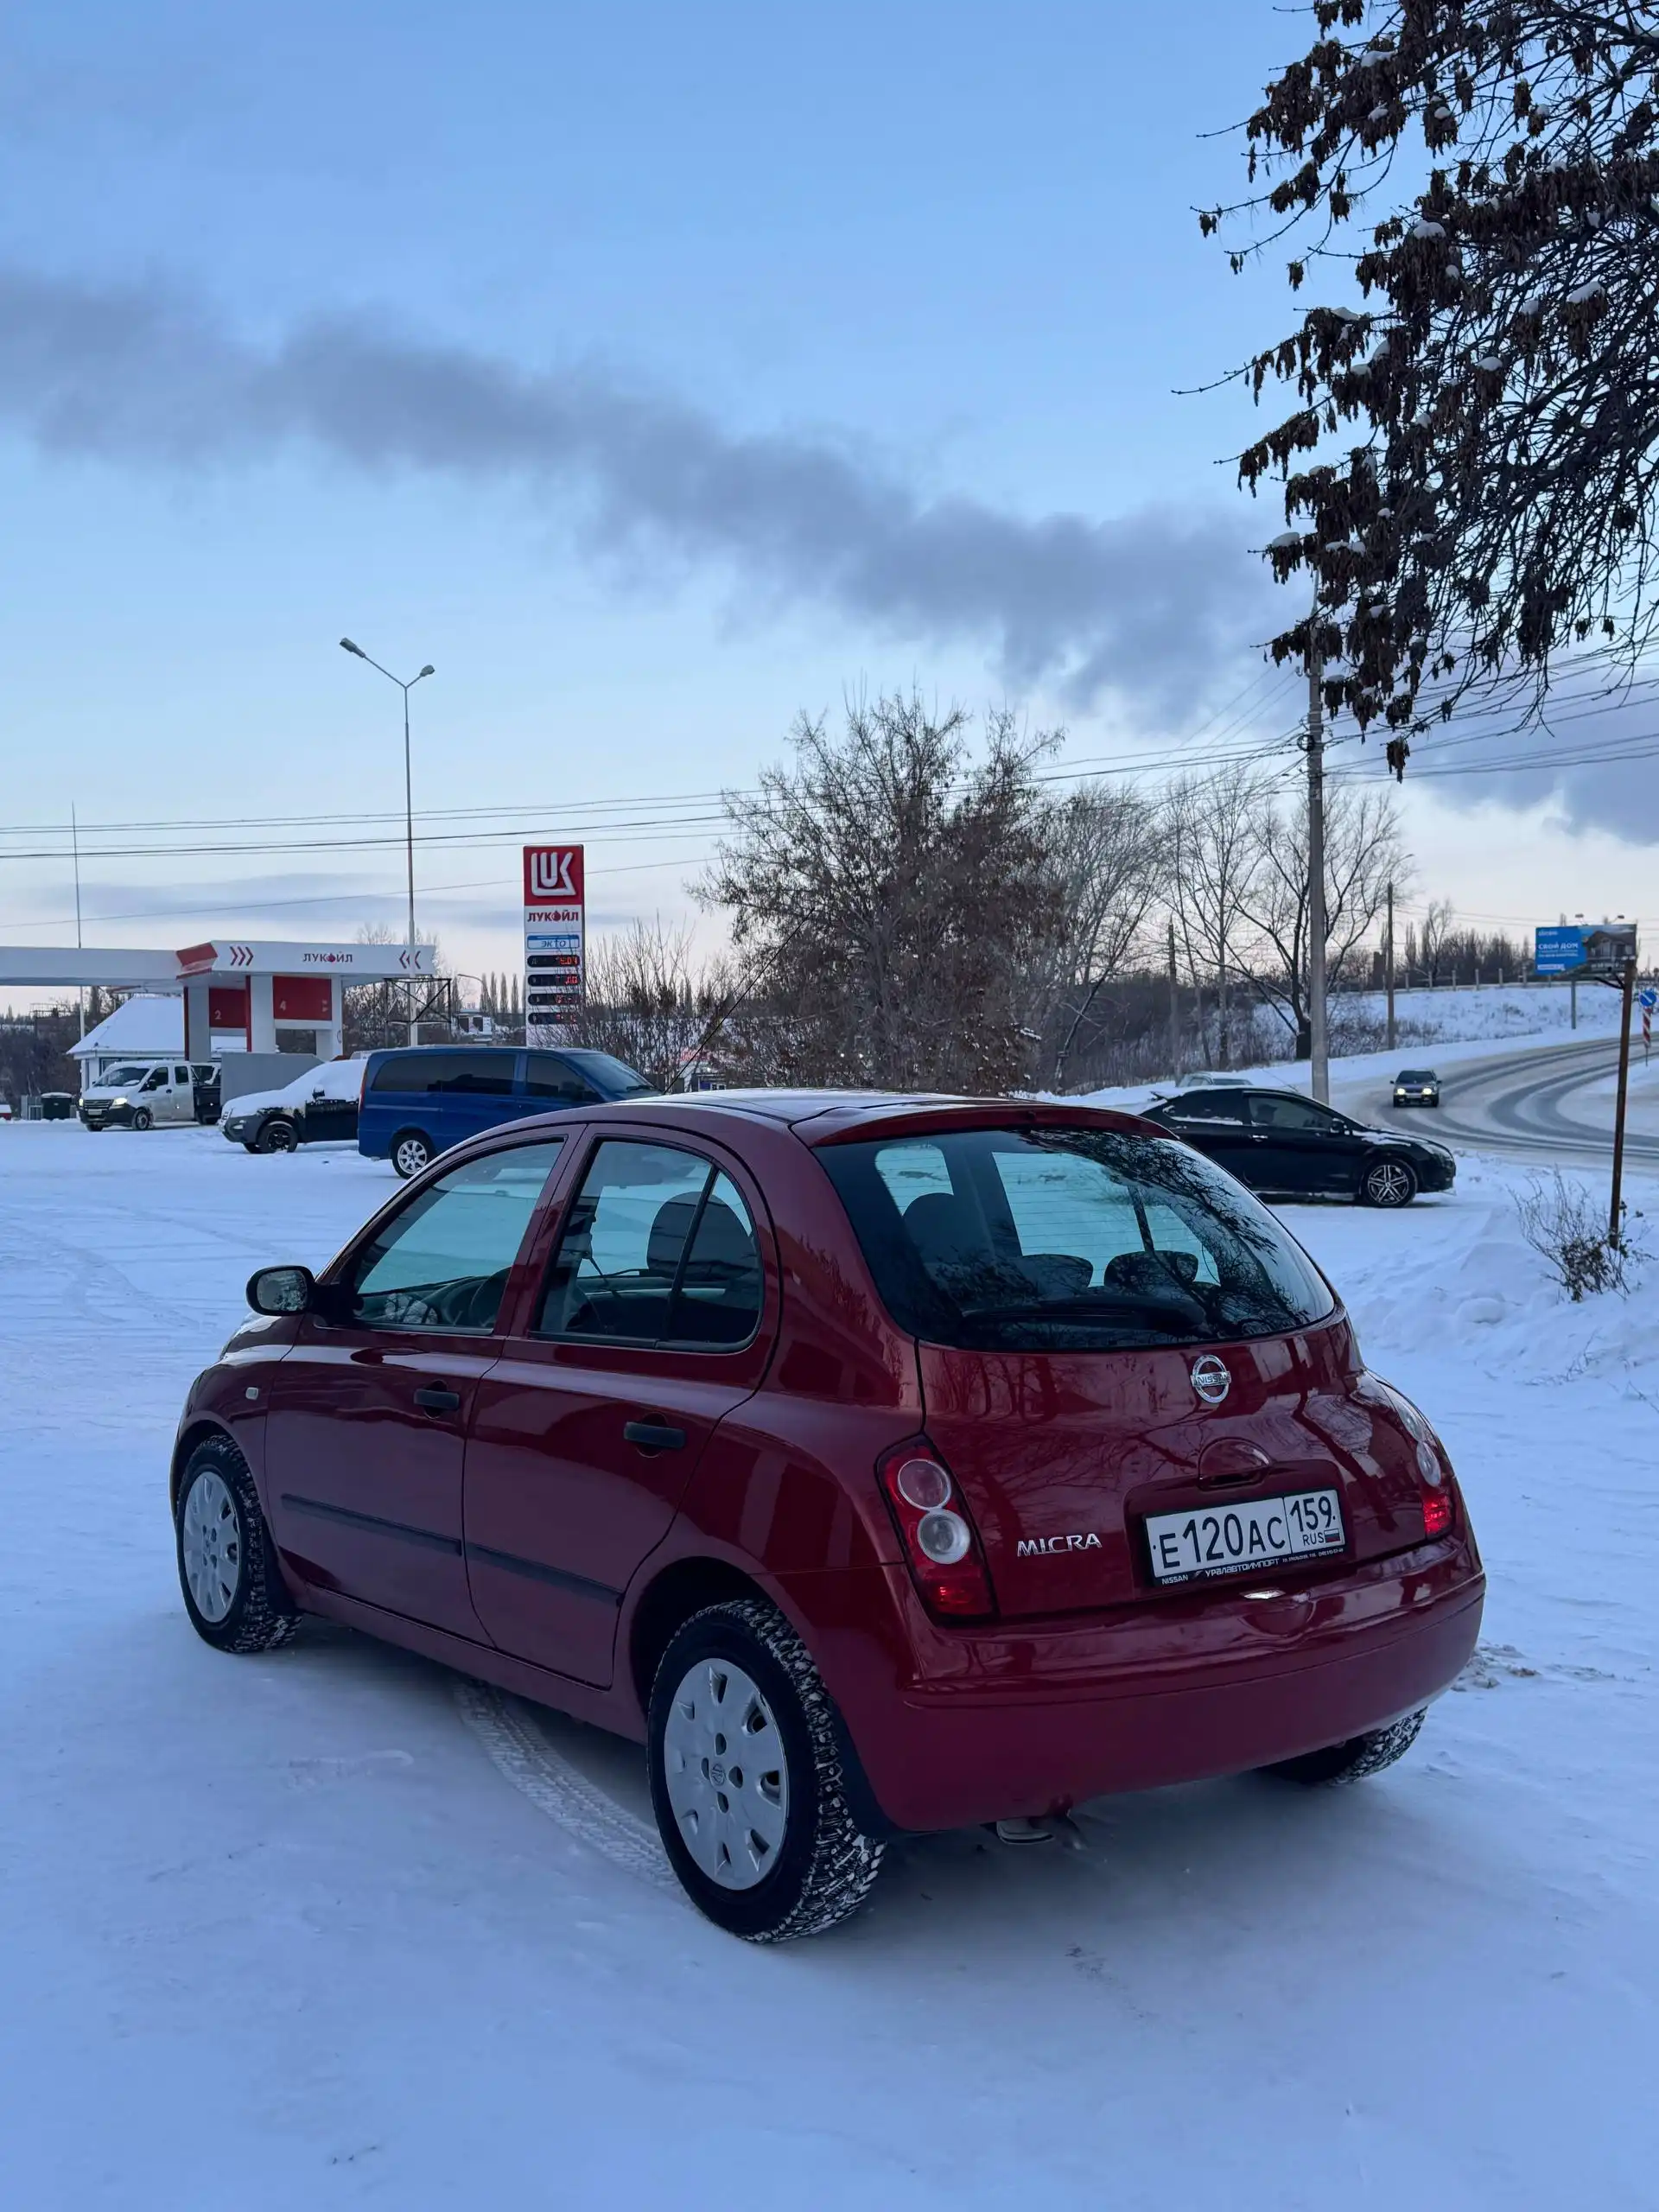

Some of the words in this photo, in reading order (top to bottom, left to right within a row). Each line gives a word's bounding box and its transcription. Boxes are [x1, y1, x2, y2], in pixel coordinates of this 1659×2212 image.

[527, 909, 579, 922] ЛУКОЙЛ
[303, 951, 353, 963] ЛУКОЙЛ
[279, 1000, 287, 1012] 4
[214, 1009, 222, 1020] 2
[1289, 1496, 1332, 1532] 159
[1017, 1533, 1103, 1557] MICRA
[1302, 1531, 1325, 1547] RUS
[1161, 1574, 1189, 1586] NISSAN
